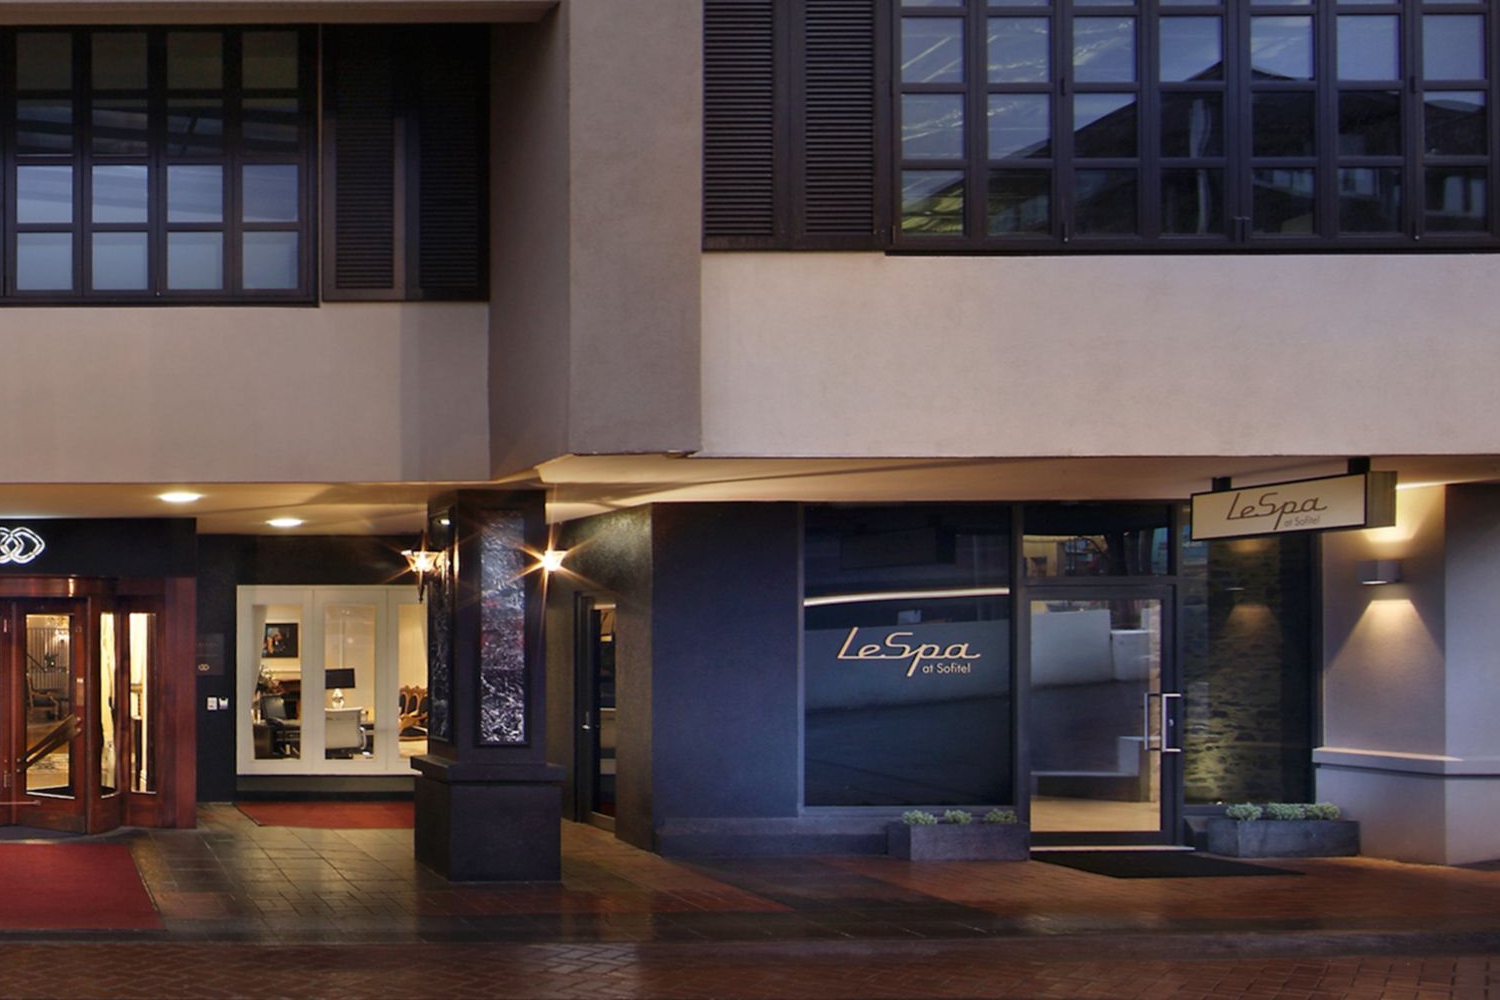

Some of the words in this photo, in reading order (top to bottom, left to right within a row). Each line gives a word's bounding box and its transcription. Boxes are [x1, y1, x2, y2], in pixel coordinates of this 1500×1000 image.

[1295, 515, 1320, 526] Sofitel
[922, 664, 933, 674] at
[936, 662, 972, 674] Sofitel
